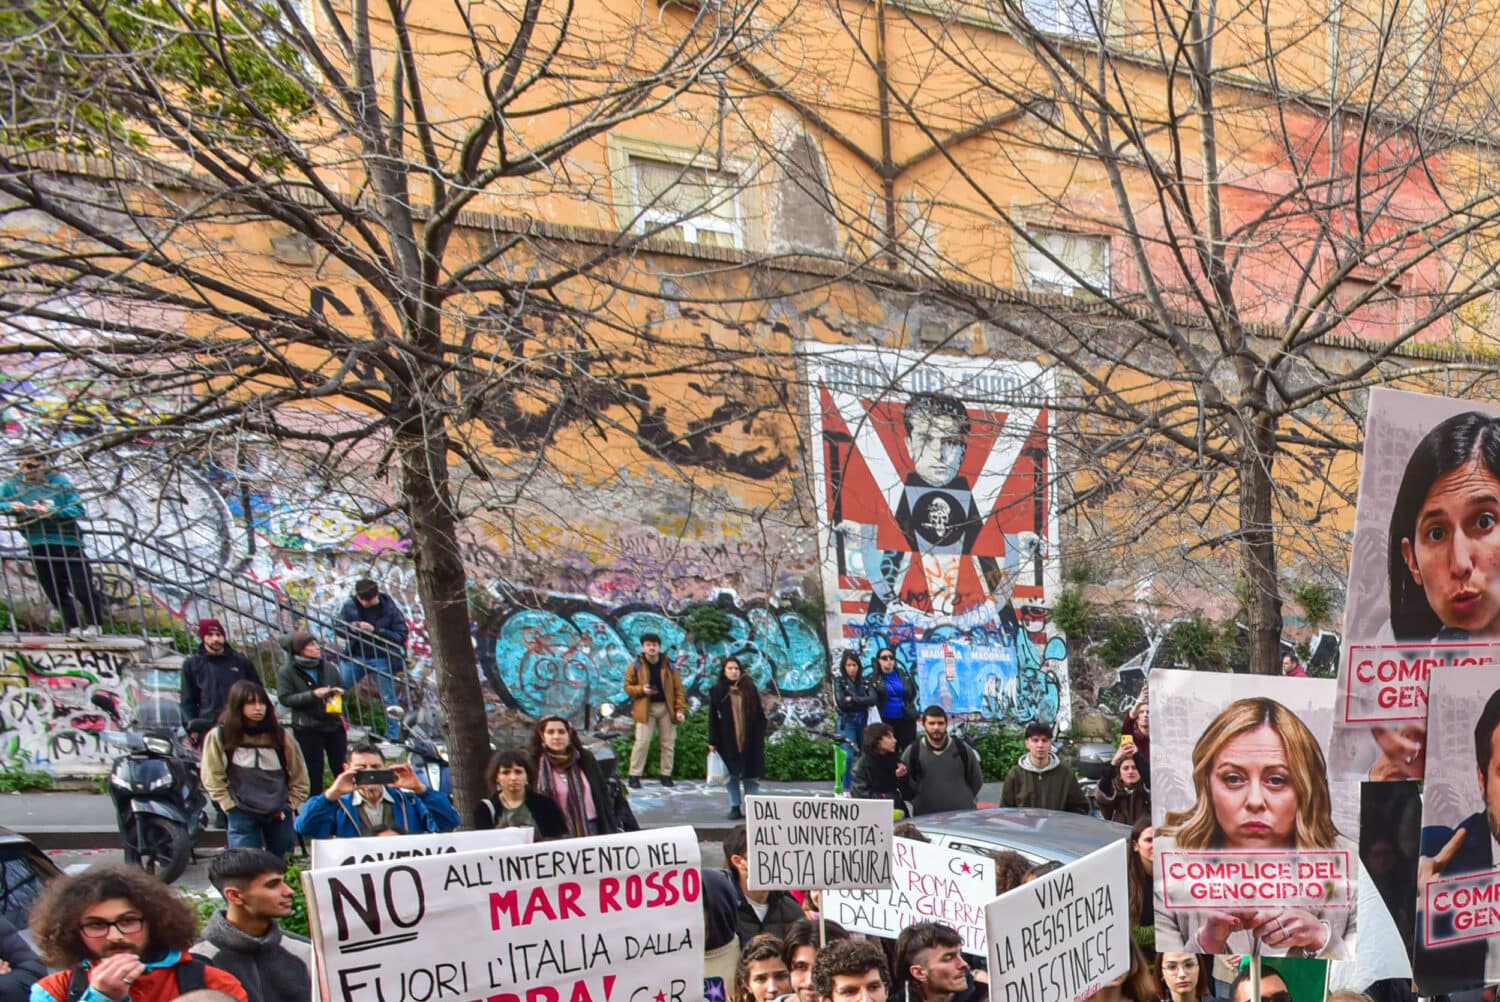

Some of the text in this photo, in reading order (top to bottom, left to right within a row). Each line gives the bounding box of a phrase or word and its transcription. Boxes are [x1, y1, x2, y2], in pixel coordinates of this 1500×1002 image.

[754, 800, 859, 820] DAL GOVERNO
[757, 849, 816, 885] BASTA
[823, 848, 892, 886] CENSURA
[1169, 861, 1343, 880] COMPLICE DEL
[328, 865, 426, 942] NO
[443, 844, 641, 891] ALL'INTERVENTO
[648, 842, 688, 868] NEL
[488, 867, 701, 931] MAR ROSSO
[908, 870, 966, 903] ROMA
[1034, 872, 1075, 910] VIVA
[1190, 881, 1325, 900] GENOCIDIO
[624, 928, 693, 962] DALLA
[994, 884, 1115, 976] LA RESISTENZA
